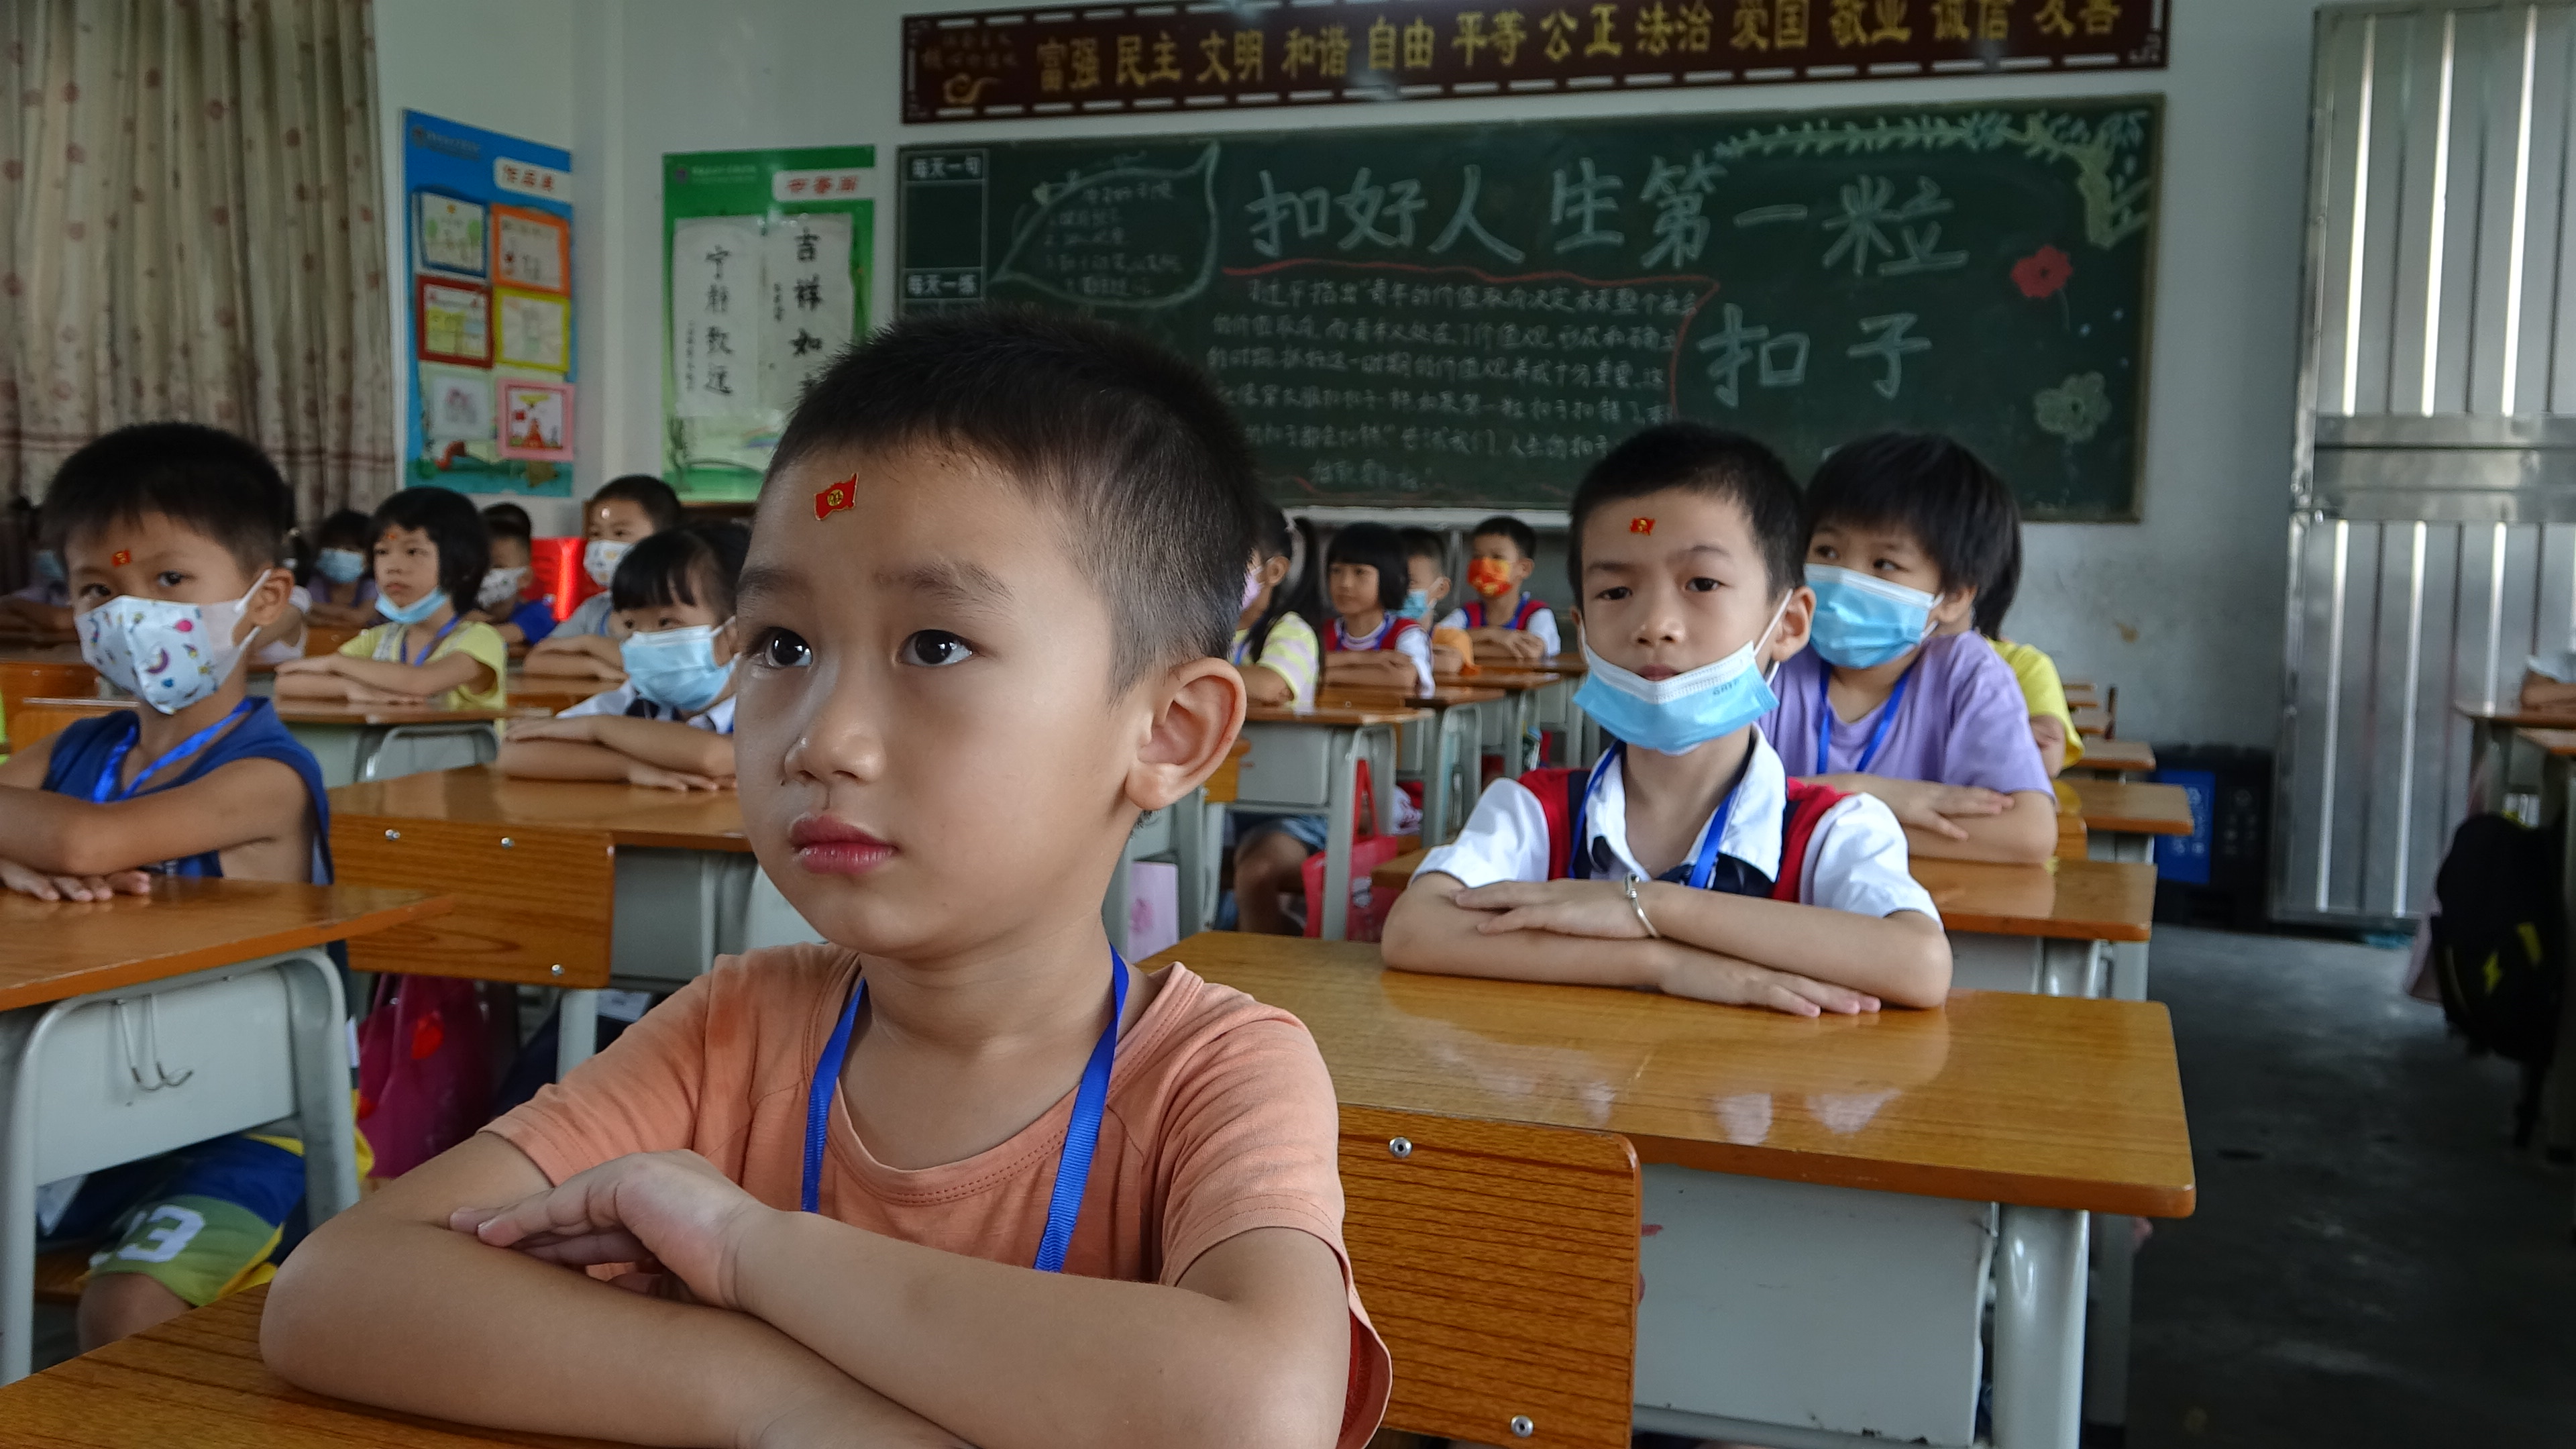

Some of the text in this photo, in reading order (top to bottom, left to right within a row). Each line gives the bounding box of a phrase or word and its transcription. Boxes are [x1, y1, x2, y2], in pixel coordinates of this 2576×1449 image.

[1037, 37, 1101, 92] 富强
[1116, 31, 1183, 87] 民主
[1197, 29, 1265, 84] 文明
[1281, 25, 1351, 80] 和谐
[1367, 13, 1436, 70] 自由
[1451, 9, 1527, 66] 平等
[1540, 3, 1623, 62] 公正
[1635, 0, 1713, 56] 法治
[1696, 303, 1933, 409] 扣子
